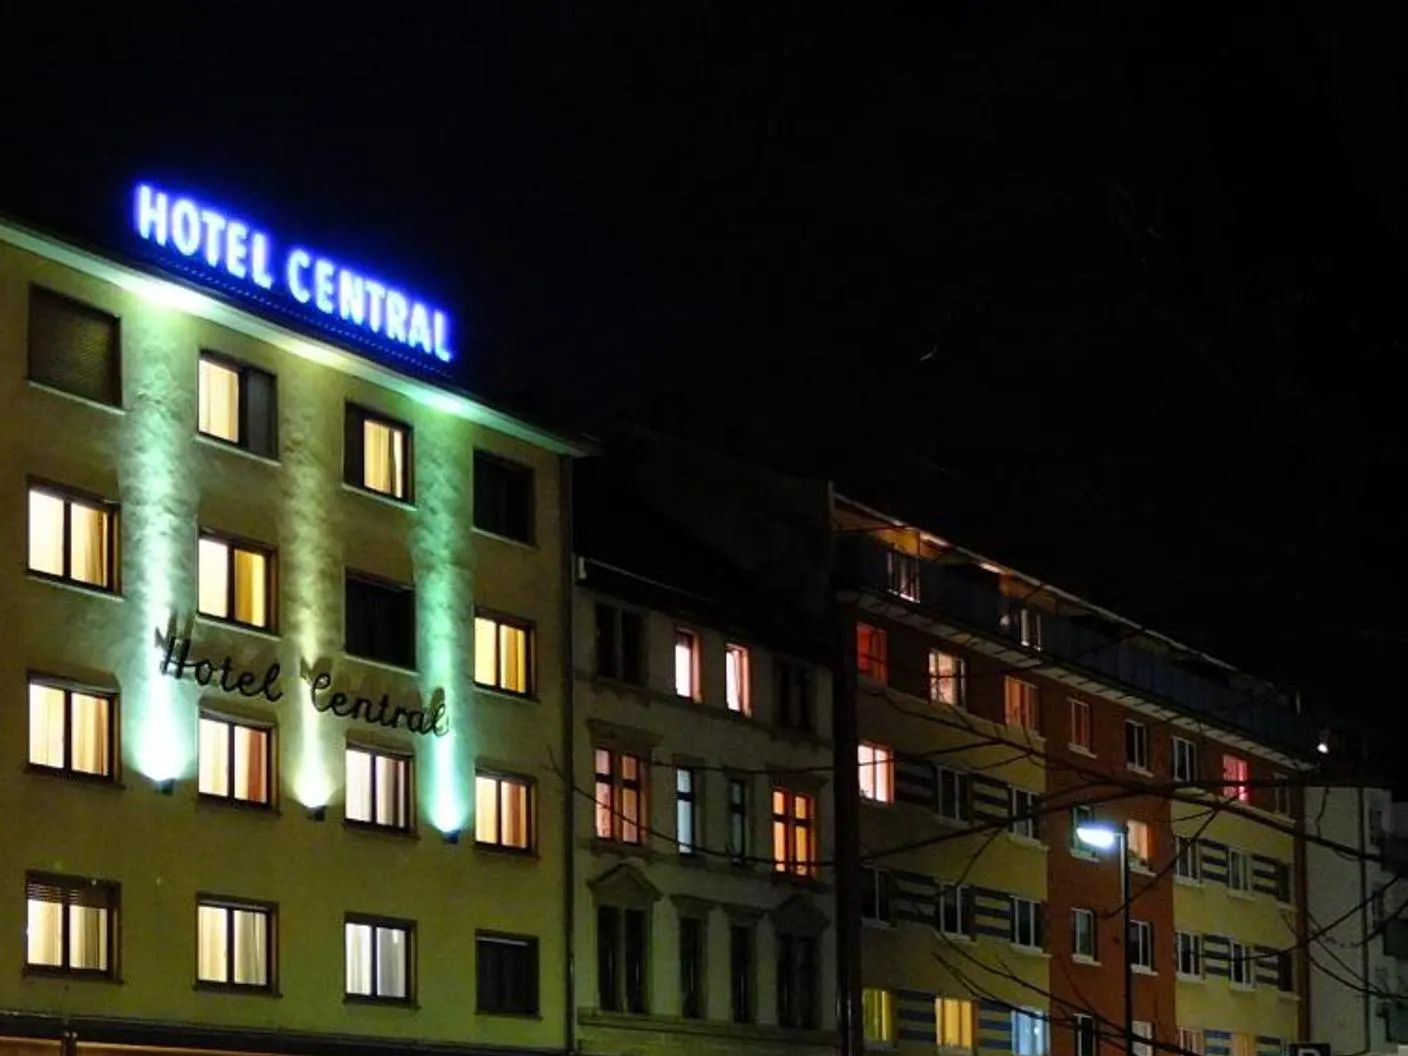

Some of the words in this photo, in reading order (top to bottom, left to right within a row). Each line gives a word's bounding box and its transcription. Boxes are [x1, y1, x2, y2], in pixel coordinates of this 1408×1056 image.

[136, 183, 273, 290] HOTEL
[287, 248, 454, 362] CENTRAL
[159, 634, 283, 702] Hotel
[310, 671, 451, 737] Central
